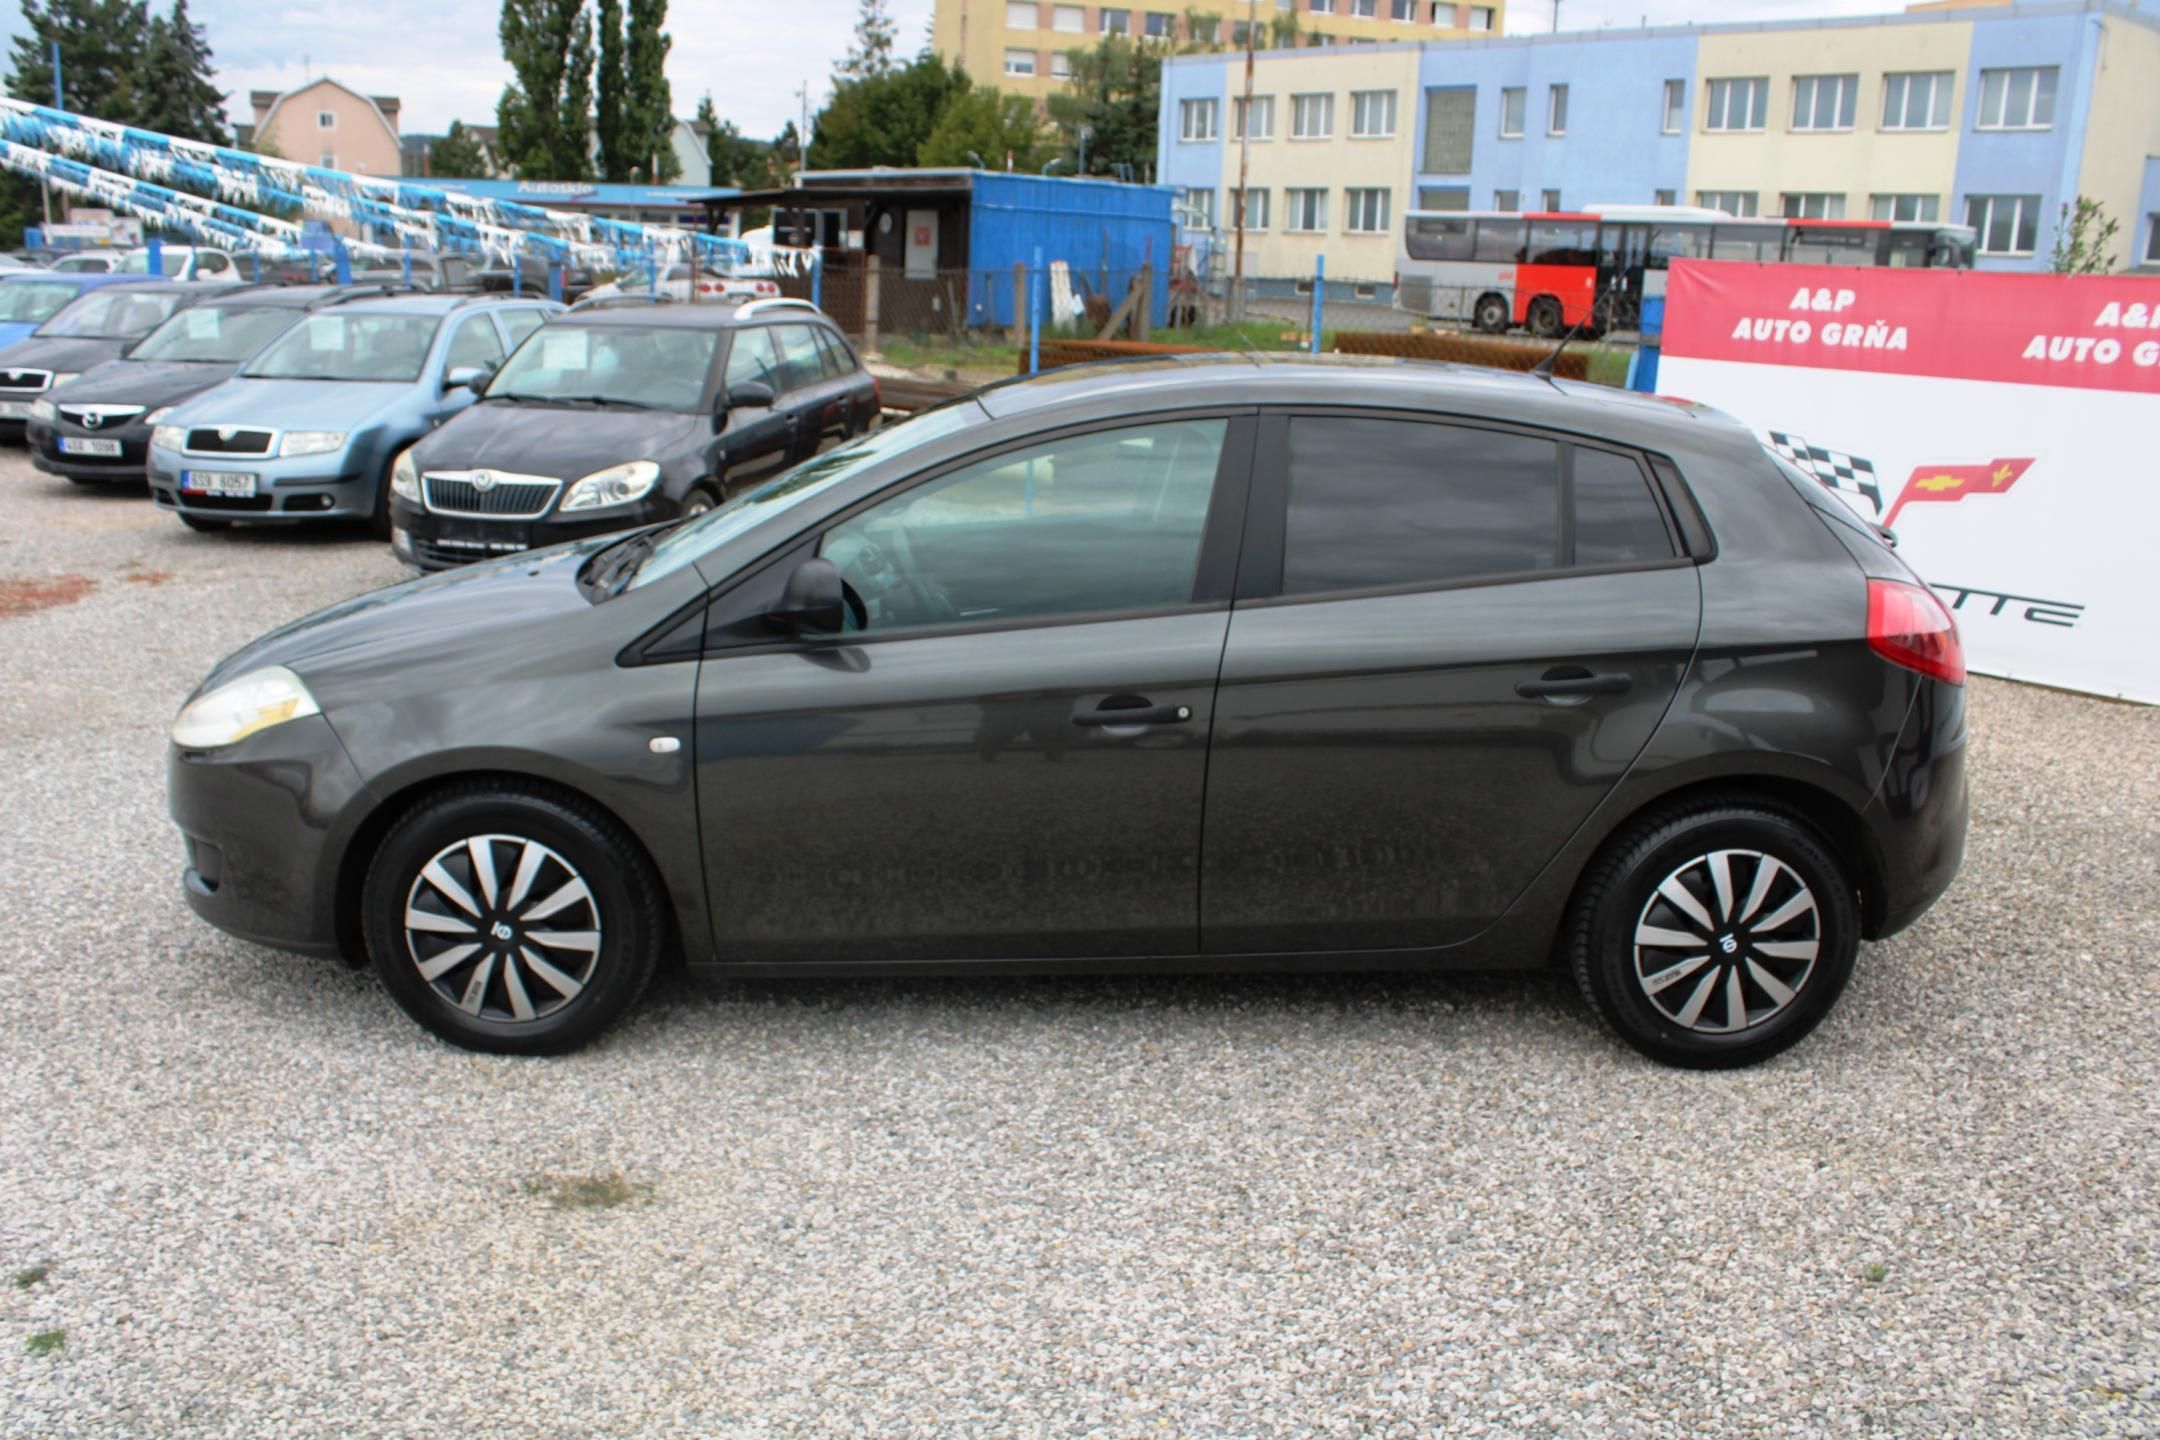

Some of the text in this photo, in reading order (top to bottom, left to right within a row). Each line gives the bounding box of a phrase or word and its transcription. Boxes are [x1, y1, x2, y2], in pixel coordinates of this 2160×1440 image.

[1789, 287, 1856, 312] A&P
[1731, 317, 1908, 351] AUTO GRŇA
[2021, 334, 2160, 368] AUTO G
[1928, 582, 2086, 628] TTE
